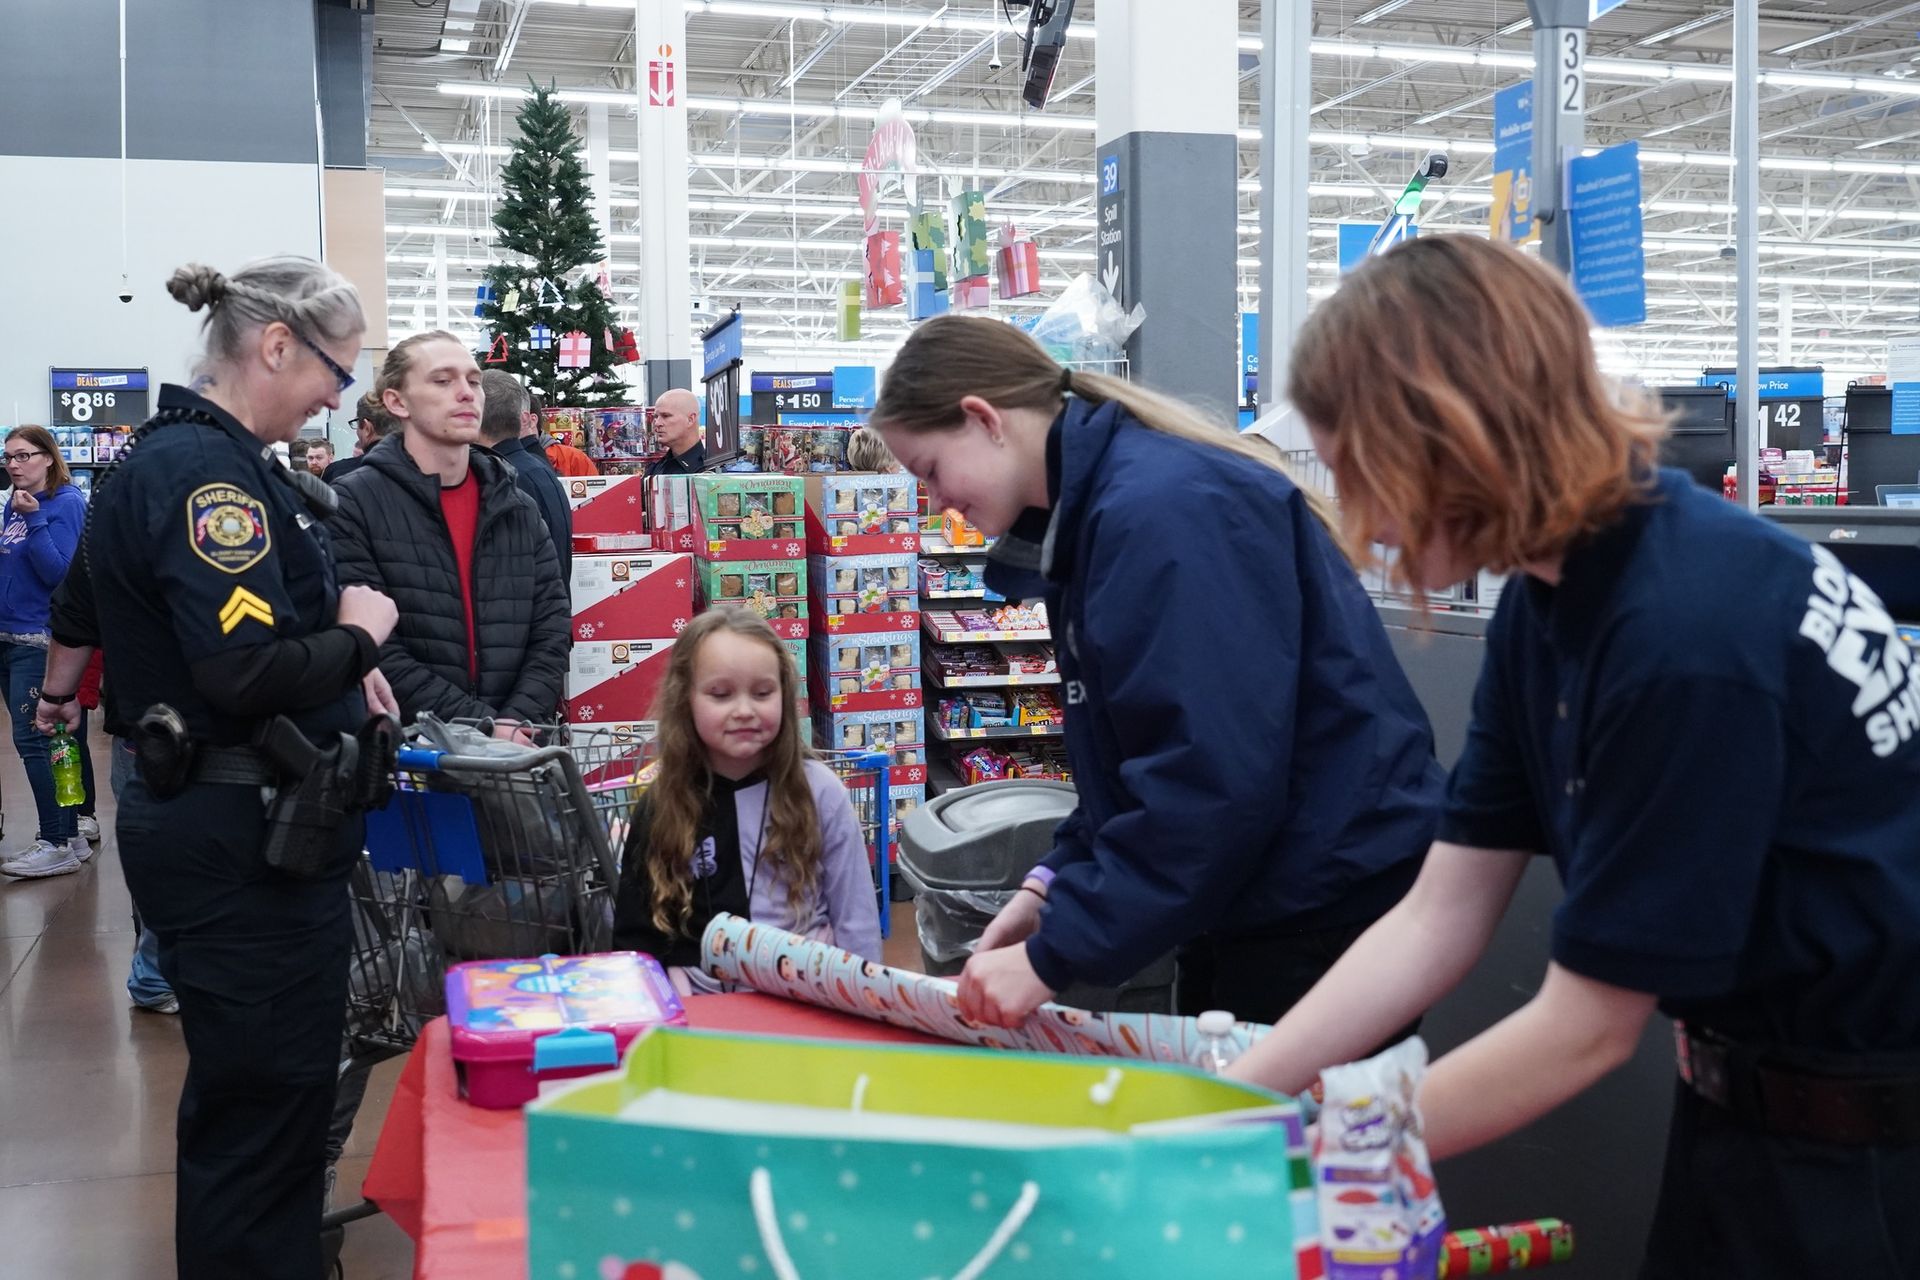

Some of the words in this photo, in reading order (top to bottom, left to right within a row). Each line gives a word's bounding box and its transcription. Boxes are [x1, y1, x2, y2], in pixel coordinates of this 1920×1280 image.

[1102, 161, 1118, 192] 39
[1104, 203, 1118, 225] Spill
[1100, 227, 1122, 247] Station
[76, 376, 100, 387] DEALS
[772, 379, 793, 389] DEALS
[1769, 380, 1789, 391] Price
[195, 489, 258, 509] SHERIFF
[857, 631, 913, 648] Stockings
[863, 708, 918, 725] Stockings
